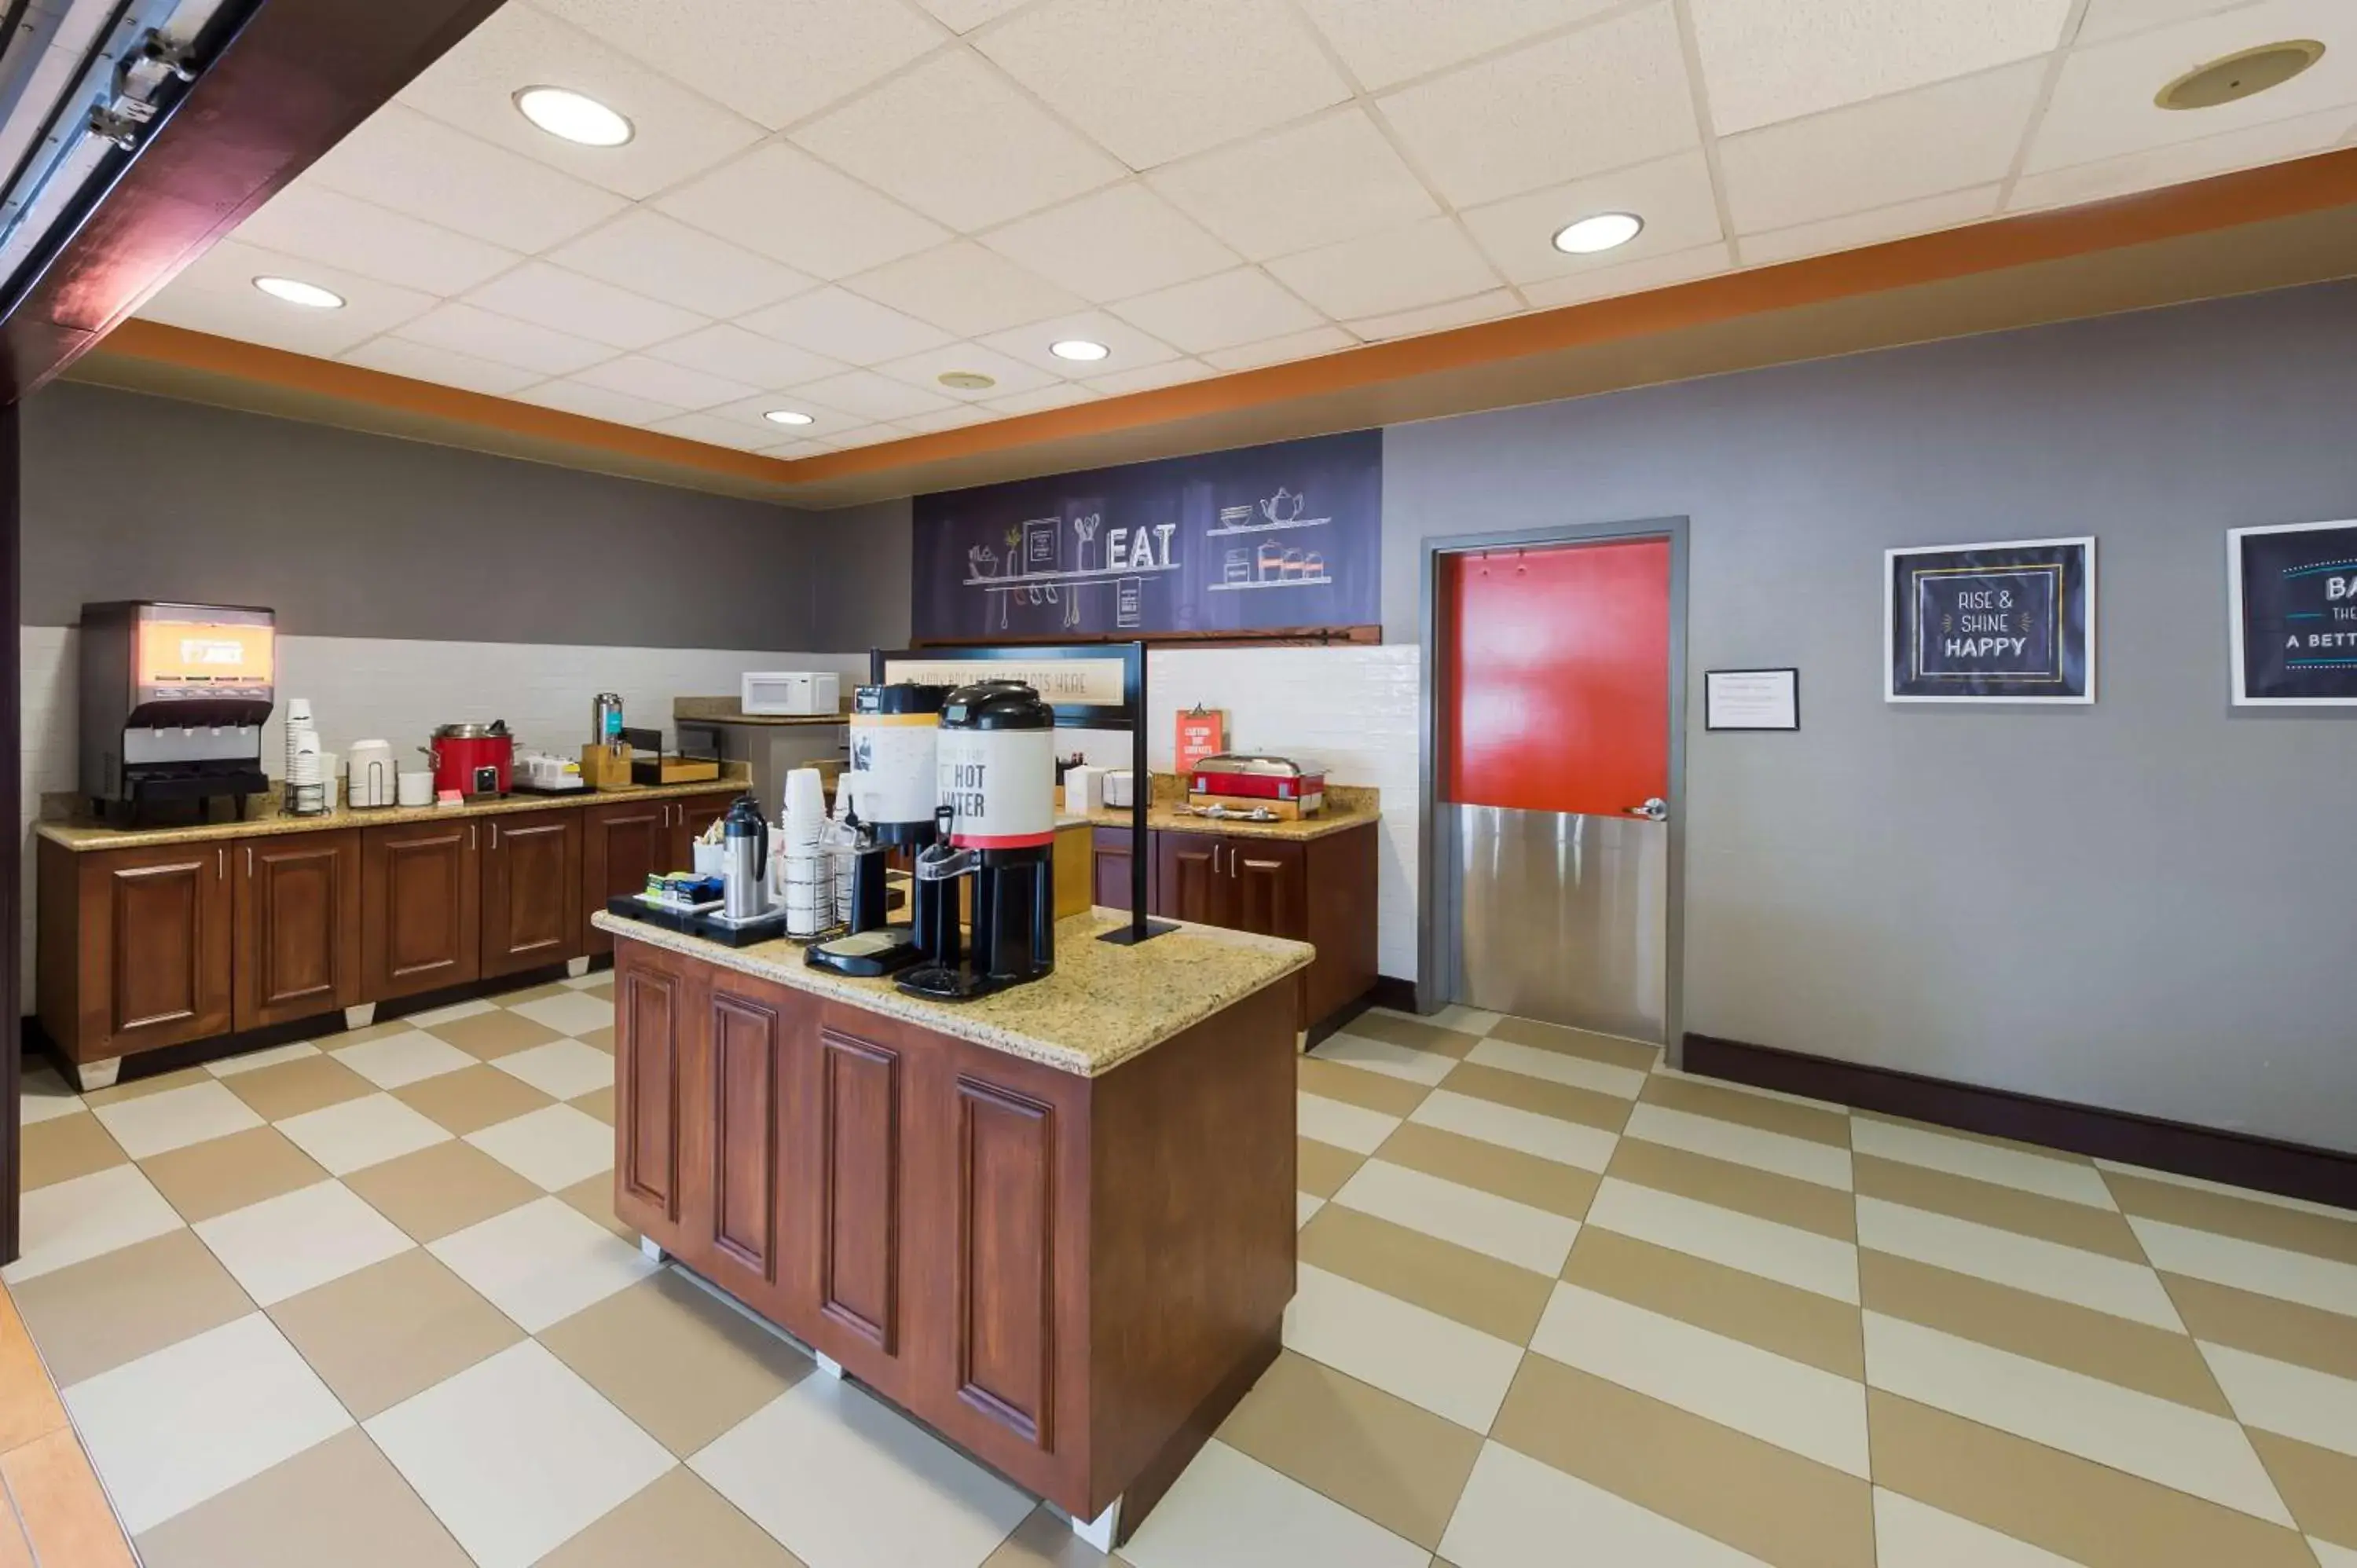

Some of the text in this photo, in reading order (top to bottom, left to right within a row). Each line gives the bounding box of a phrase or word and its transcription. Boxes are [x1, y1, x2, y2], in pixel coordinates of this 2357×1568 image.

[1106, 523, 1176, 569] EAT
[1959, 590, 2014, 610] RISE &
[1961, 614, 2009, 632] SHINE
[1945, 637, 2027, 658] HAPPY
[2286, 632, 2357, 649] A BETT
[1056, 672, 1087, 694] HERE
[955, 764, 986, 789] HOT
[941, 791, 984, 817] WATER
